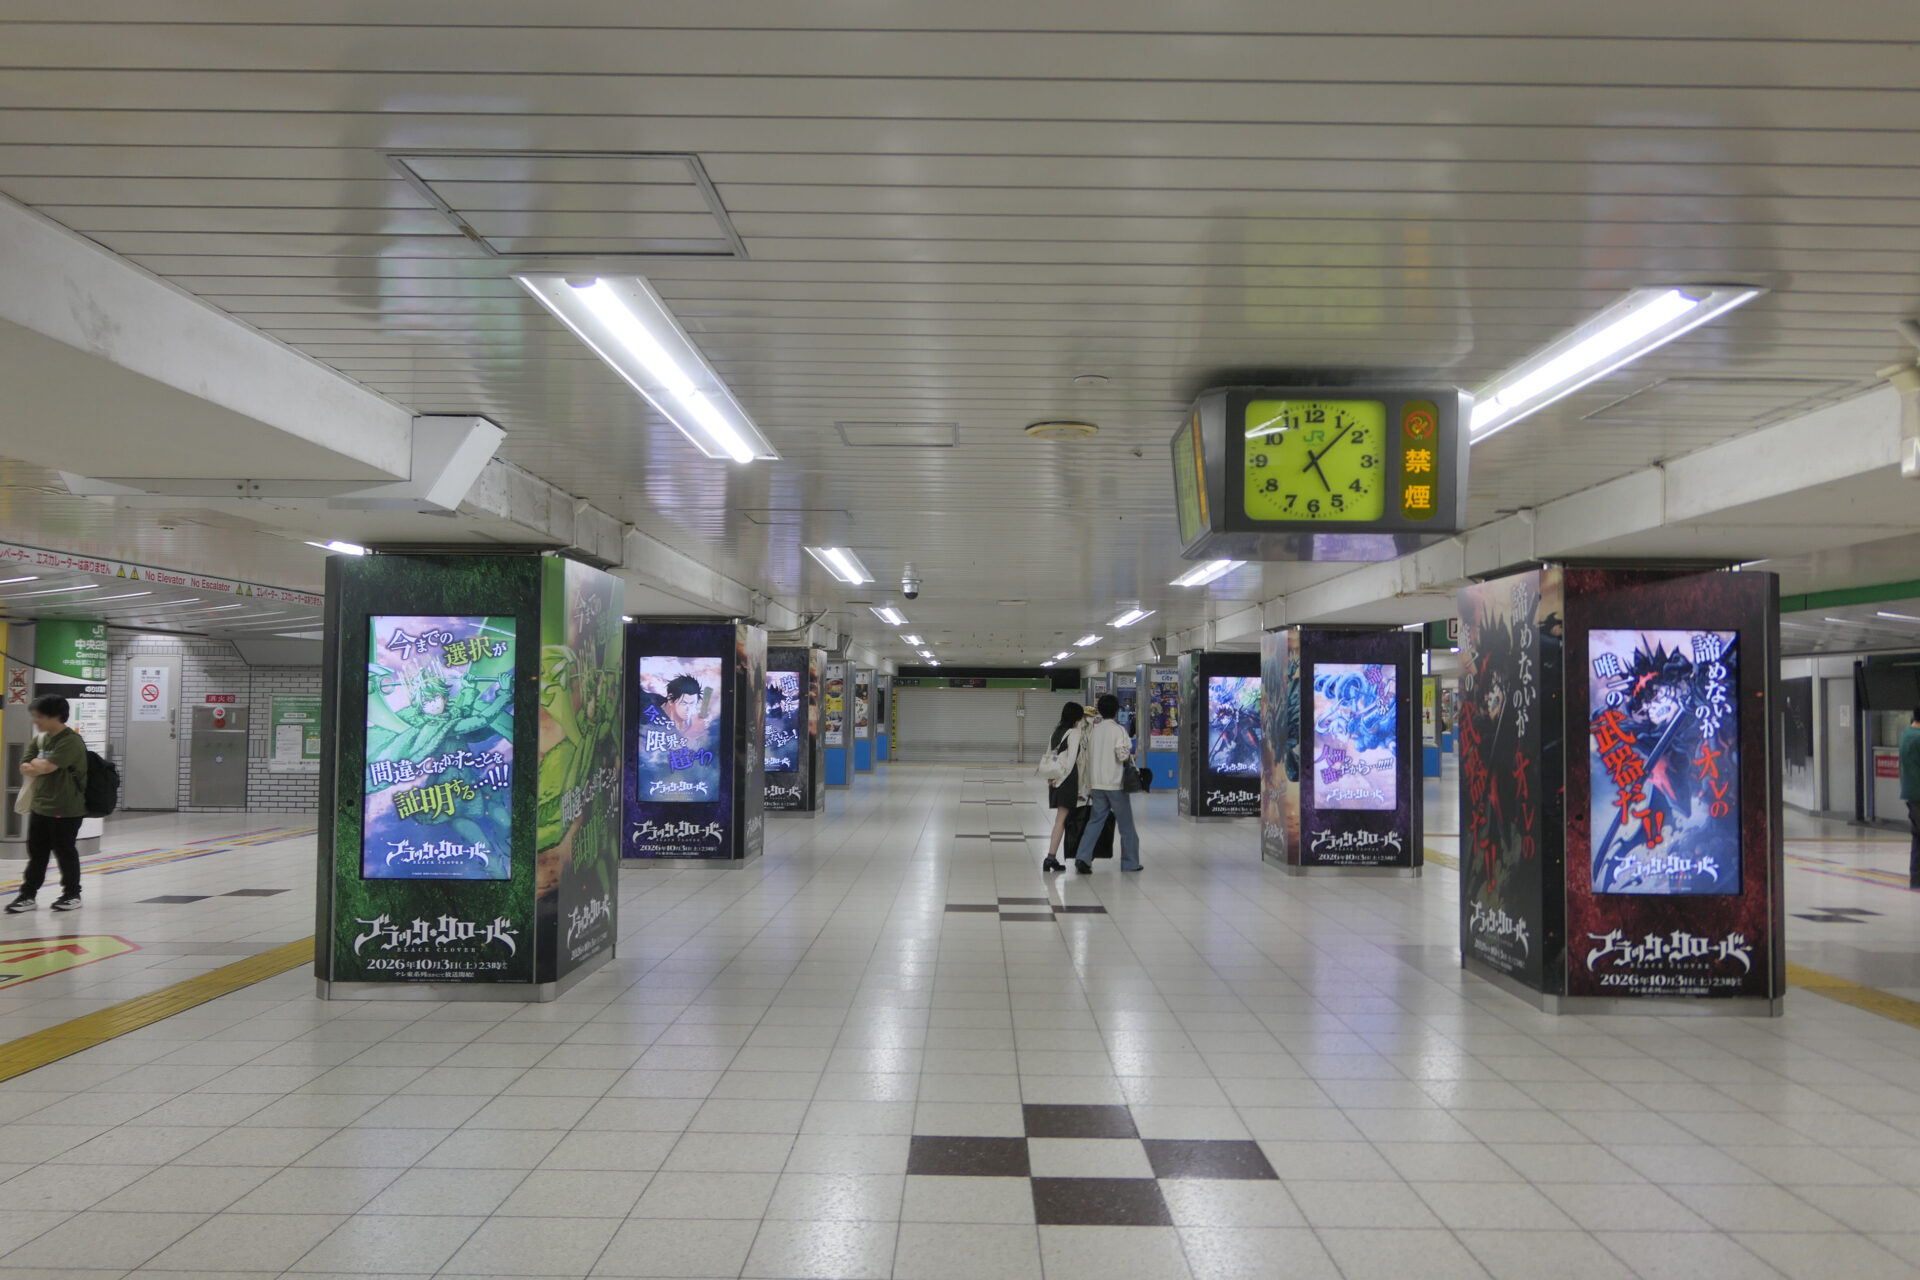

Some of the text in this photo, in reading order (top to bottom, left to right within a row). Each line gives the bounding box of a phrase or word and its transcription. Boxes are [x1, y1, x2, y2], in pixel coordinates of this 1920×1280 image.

[1284, 415, 1299, 430] 11
[1304, 409, 1325, 424] 12
[1334, 415, 1342, 429] 1
[1264, 432, 1284, 446] 10
[1303, 430, 1325, 443] JR
[1351, 431, 1364, 444] 2
[1255, 454, 1268, 468] 9
[1361, 454, 1373, 468] 3
[1265, 478, 1278, 492] 8
[1349, 478, 1361, 492] 4
[1404, 448, 1431, 509] 禁煙
[1285, 494, 1298, 508] 7
[1307, 499, 1320, 513] 6
[1331, 494, 1344, 508] 5
[145, 570, 231, 592] No Elevator No Escalator
[93, 625, 105, 635] JR
[387, 629, 454, 660] 今までの
[444, 636, 507, 668] 選択が
[1512, 582, 1536, 738] 諦めないのが
[1593, 652, 1635, 706] 唯一の
[1692, 633, 1733, 738] 諦めないのが
[645, 730, 688, 752] 限界を
[370, 750, 503, 786] 間違ってなかったことを
[1591, 710, 1664, 850] 武器だ!!
[1693, 746, 1729, 818] オレの
[1512, 749, 1536, 860] オレの
[632, 820, 724, 845] ブラック・クローバー
[1311, 828, 1403, 855] ブラック・クローバー
[386, 839, 491, 868] ブラック・クローバー
[1613, 854, 1719, 883] ブラック・クローバー
[354, 912, 520, 958] ブラック・クローバー
[1586, 928, 1753, 974] ブラック・クローバー
